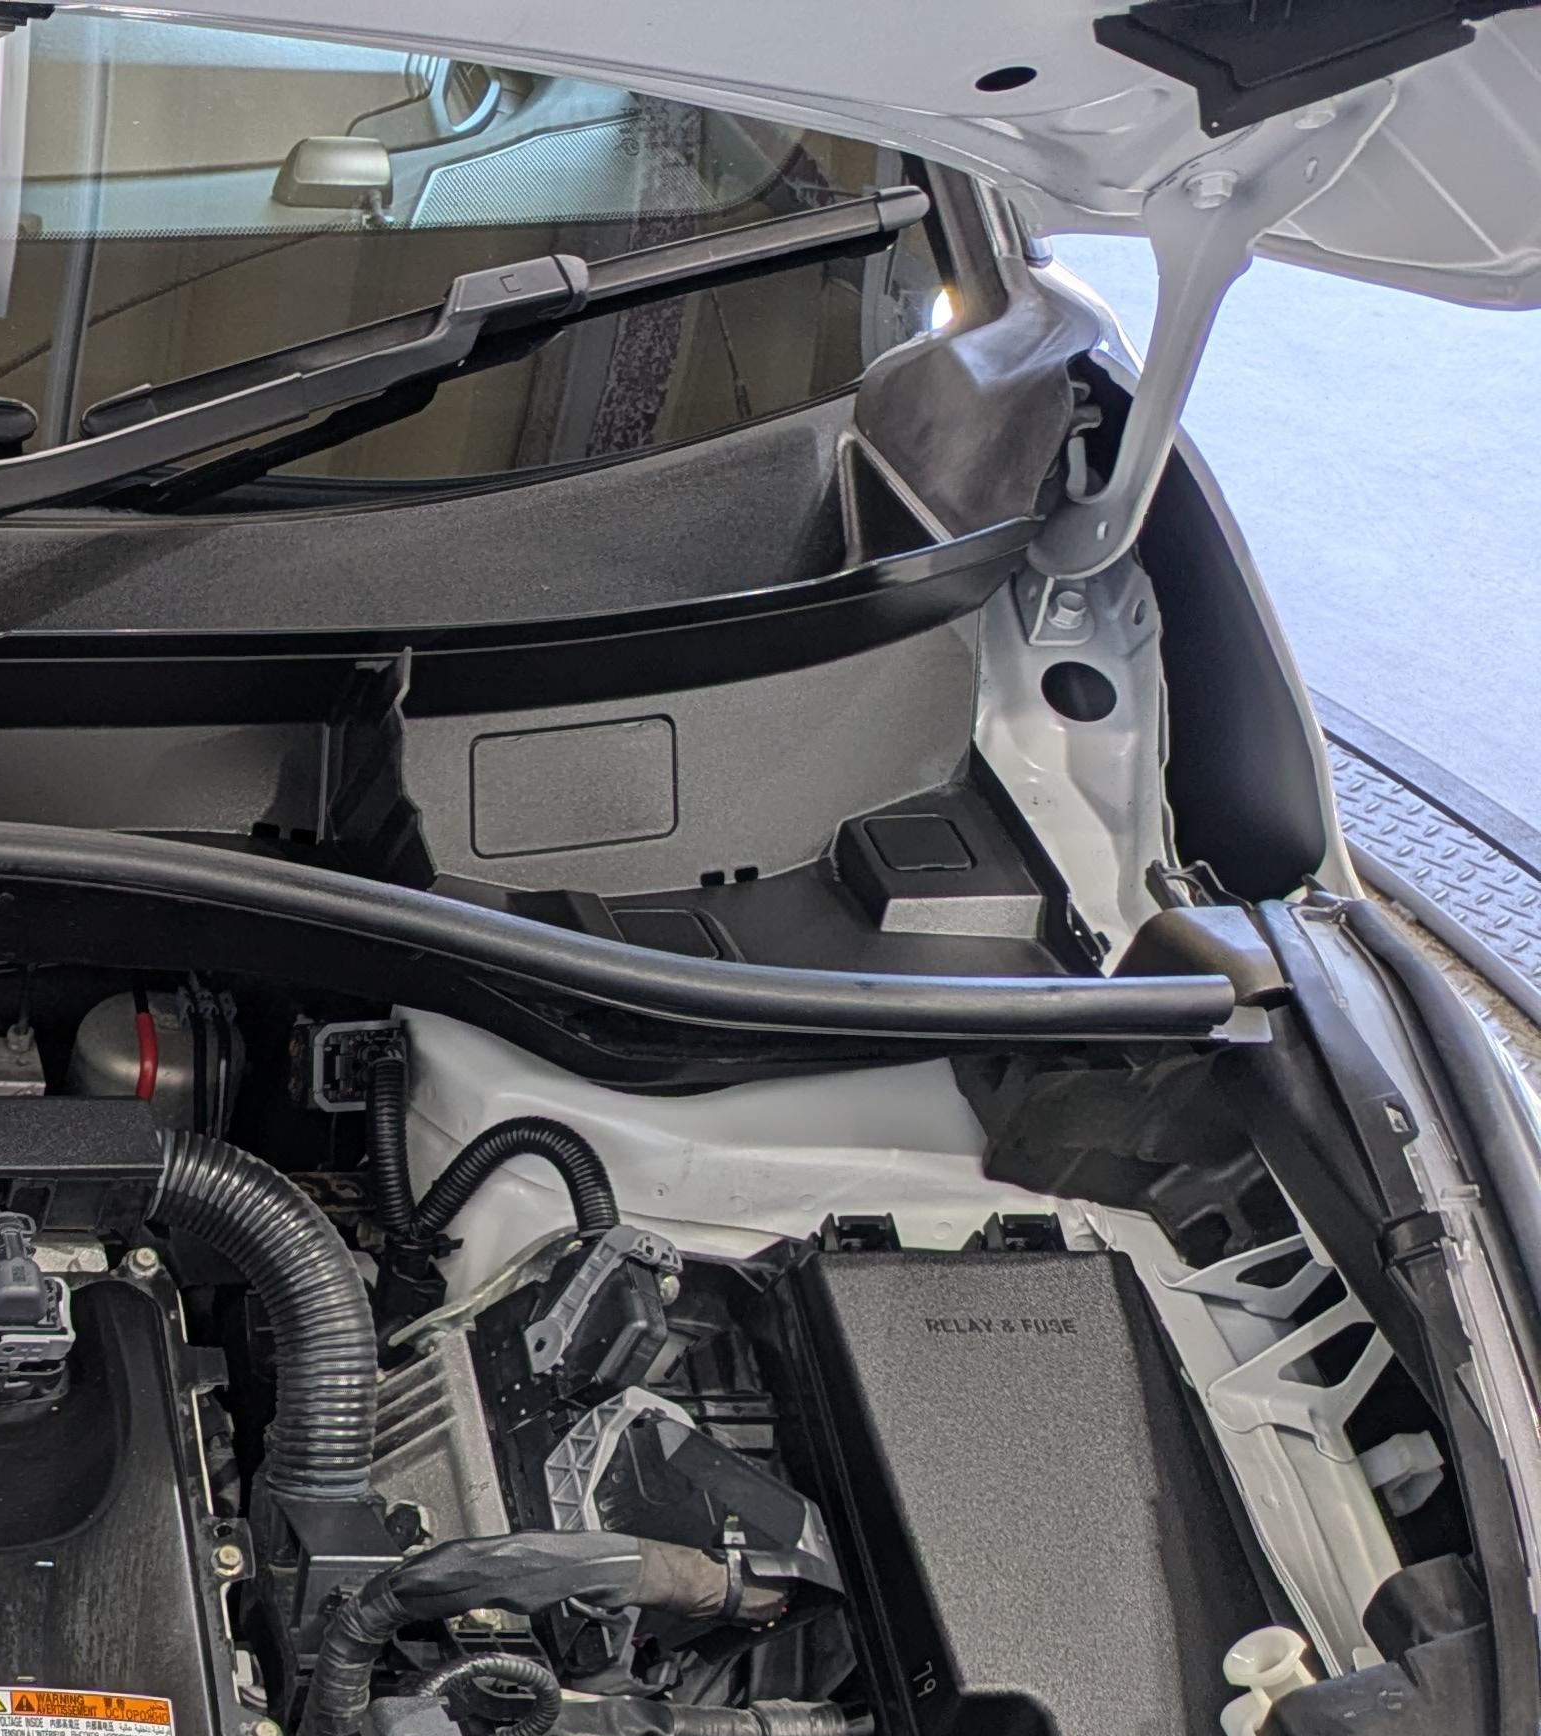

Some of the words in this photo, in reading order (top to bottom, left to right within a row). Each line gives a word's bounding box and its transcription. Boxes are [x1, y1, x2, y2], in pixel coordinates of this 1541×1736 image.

[924, 1317, 993, 1333] RELAY
[1000, 1319, 1015, 1333] &
[1020, 1318, 1078, 1334] FUSE
[37, 1692, 84, 1706] WARNING
[25, 1717, 43, 1728] INSIDE
